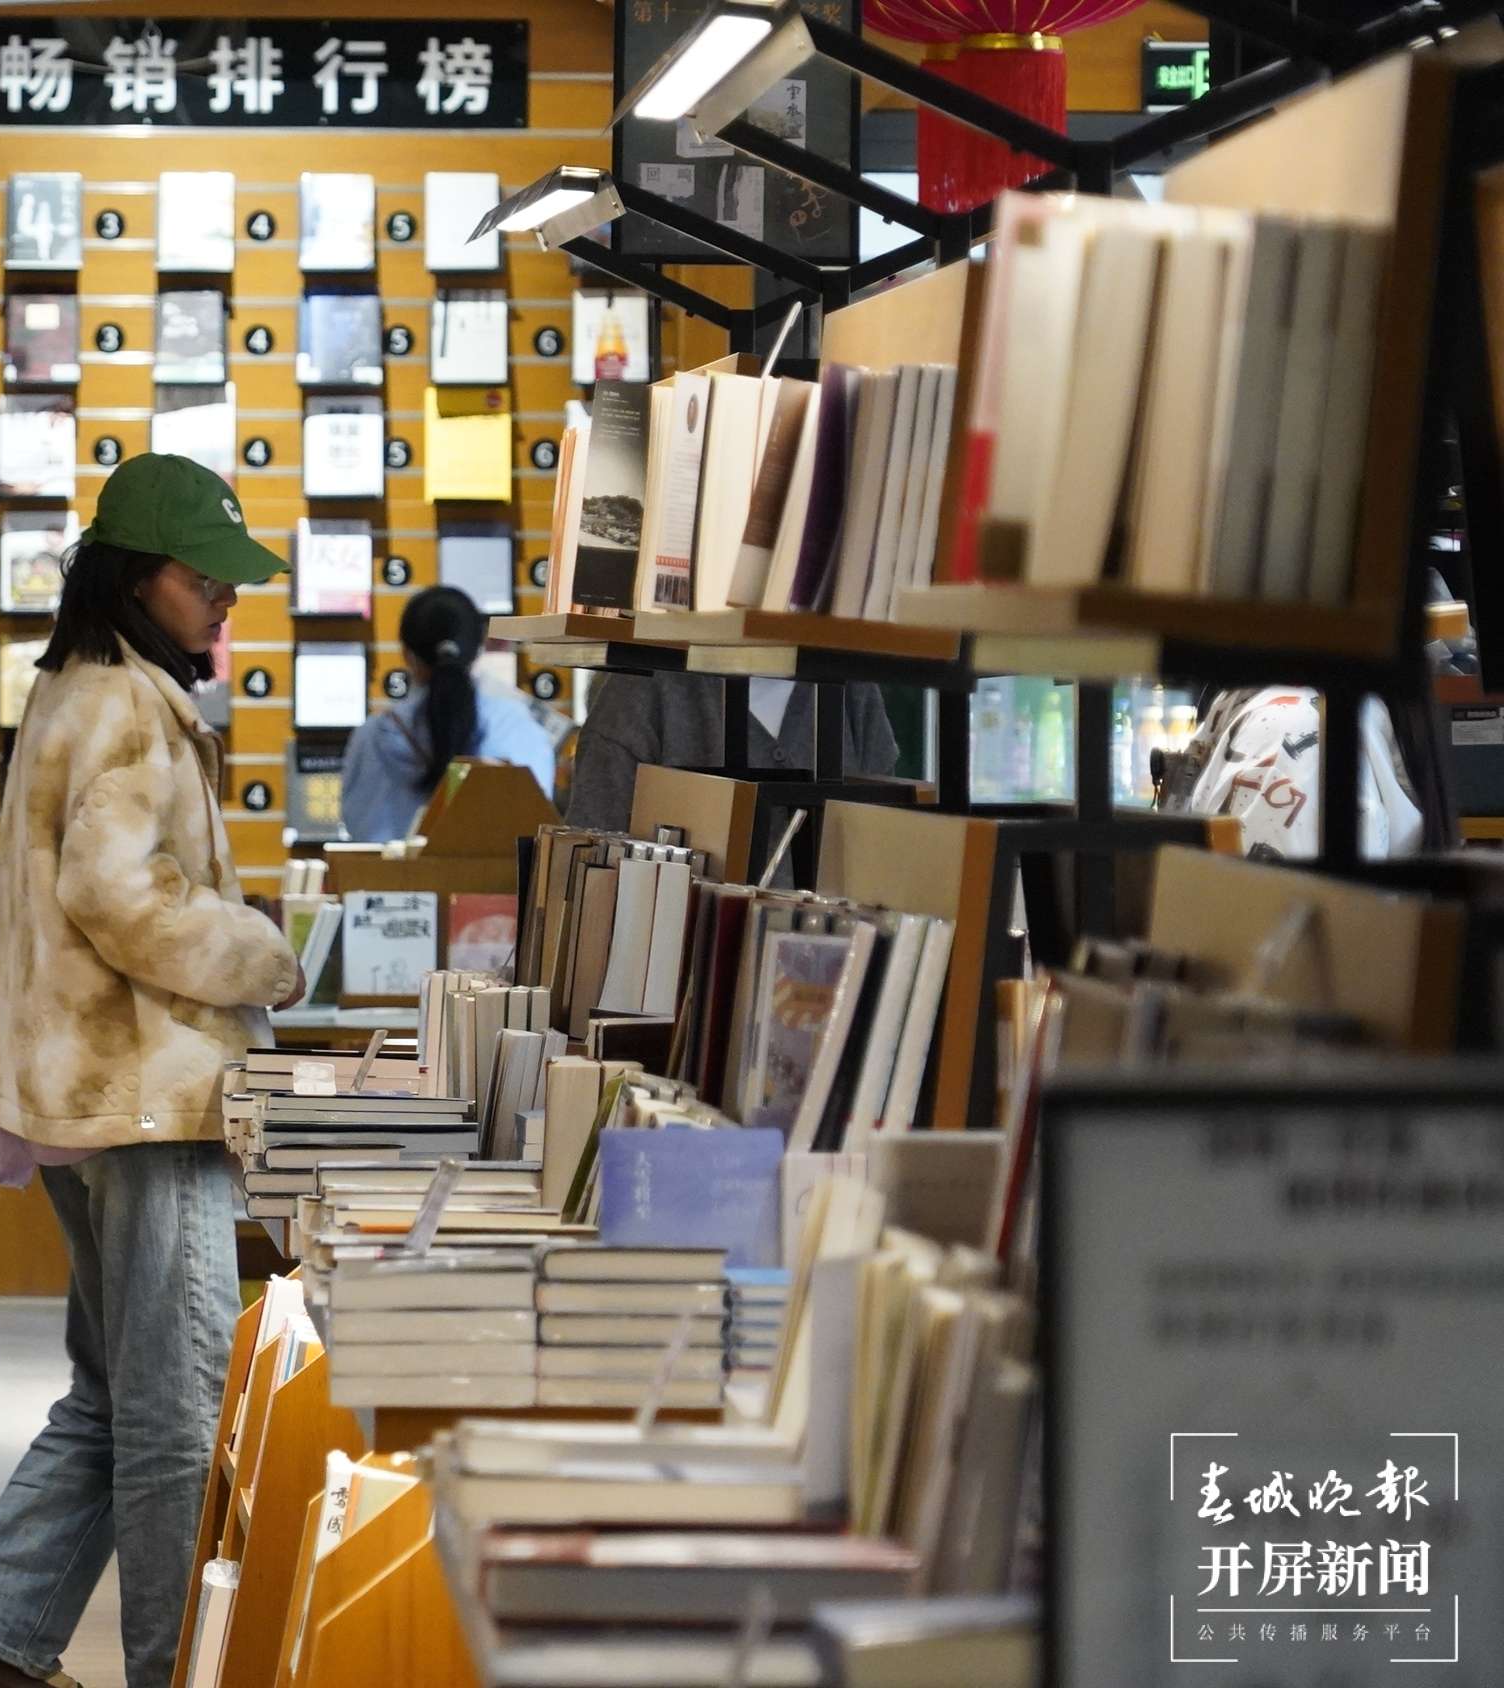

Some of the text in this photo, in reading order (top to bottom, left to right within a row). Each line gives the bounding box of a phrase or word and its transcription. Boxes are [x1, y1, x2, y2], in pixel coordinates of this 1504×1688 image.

[102, 213, 119, 239] 3
[249, 215, 270, 239] 4
[393, 215, 409, 239] 5
[102, 326, 118, 351] 3
[248, 329, 268, 352] 4
[391, 328, 407, 352] 5
[540, 330, 556, 353] 6
[100, 439, 117, 464] 3
[246, 441, 266, 465] 4
[390, 442, 406, 465] 5
[536, 443, 553, 466] 6
[221, 498, 242, 524] C
[389, 560, 405, 584] 5
[246, 671, 266, 694] 4
[390, 672, 406, 696] 5
[536, 673, 553, 697] 6
[246, 785, 266, 808] 4
